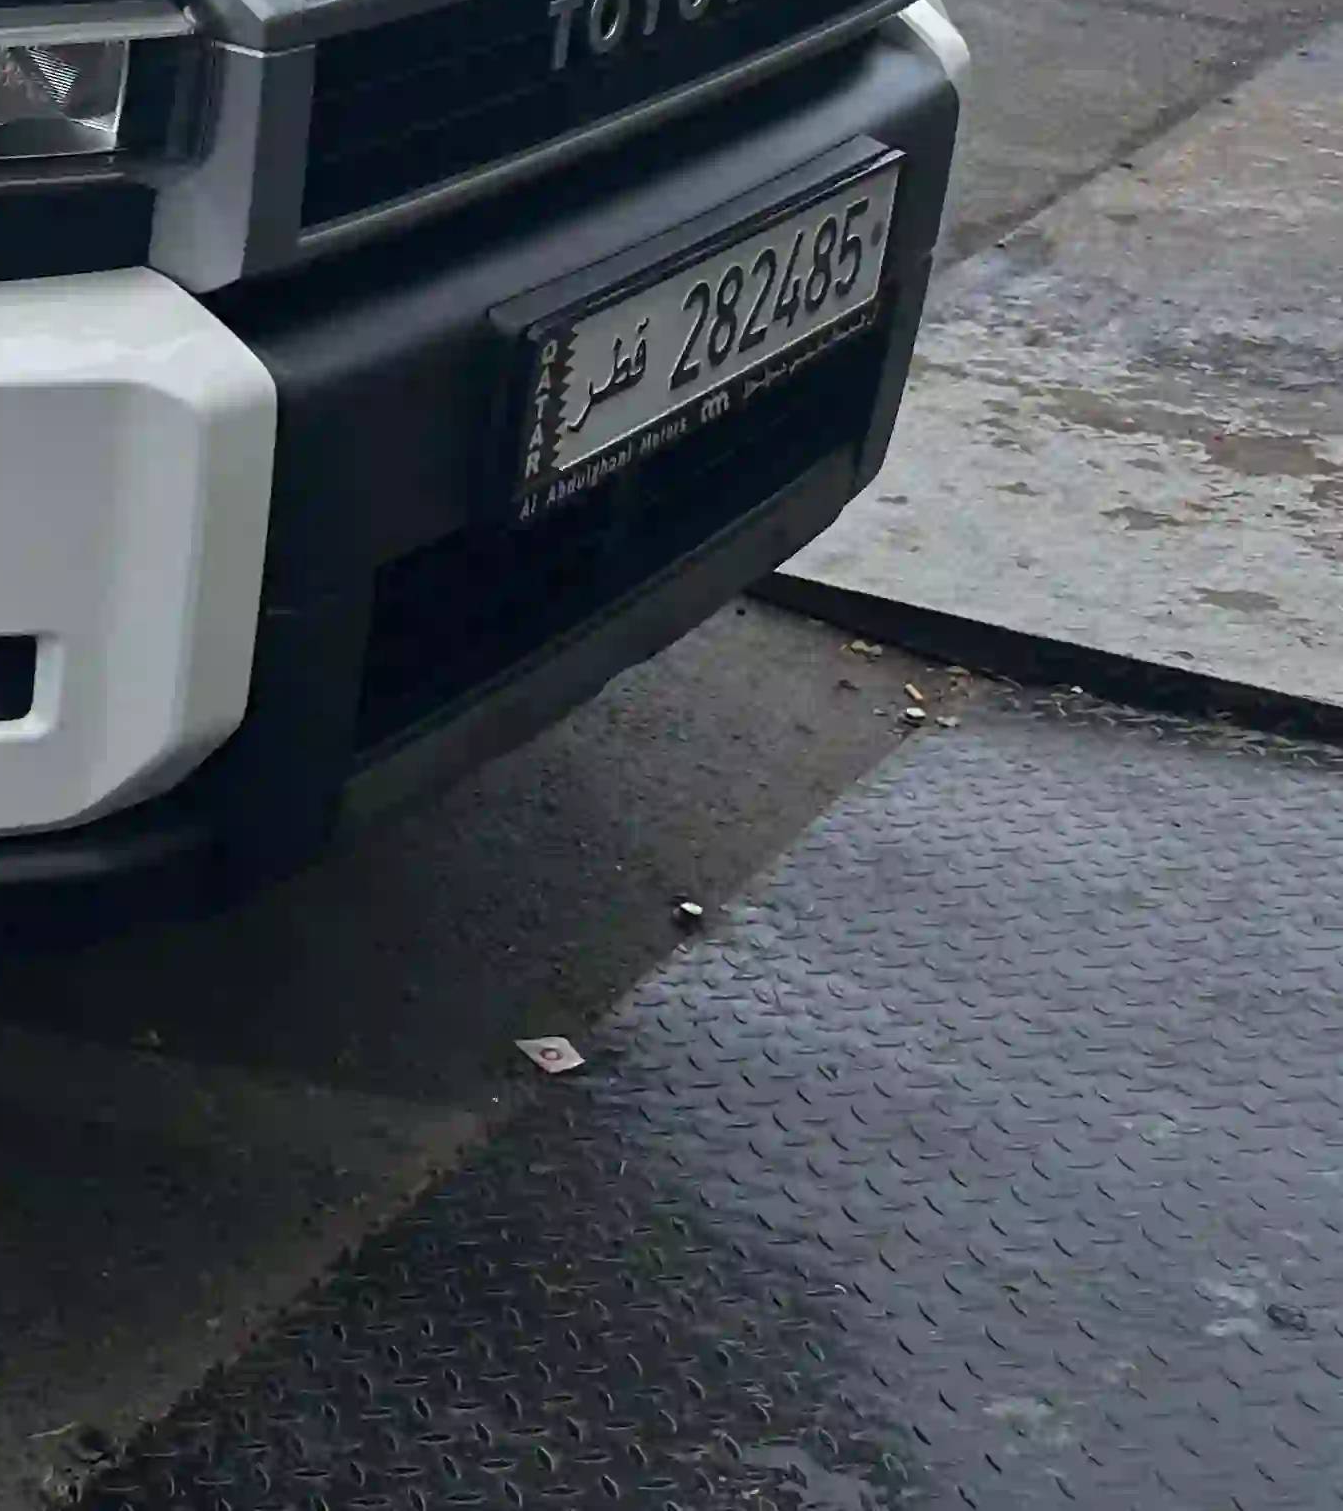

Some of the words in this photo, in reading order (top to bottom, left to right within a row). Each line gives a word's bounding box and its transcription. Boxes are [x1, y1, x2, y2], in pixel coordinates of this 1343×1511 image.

[668, 198, 869, 391] 282485
[525, 340, 558, 479] QATAR
[567, 317, 649, 432] قطر
